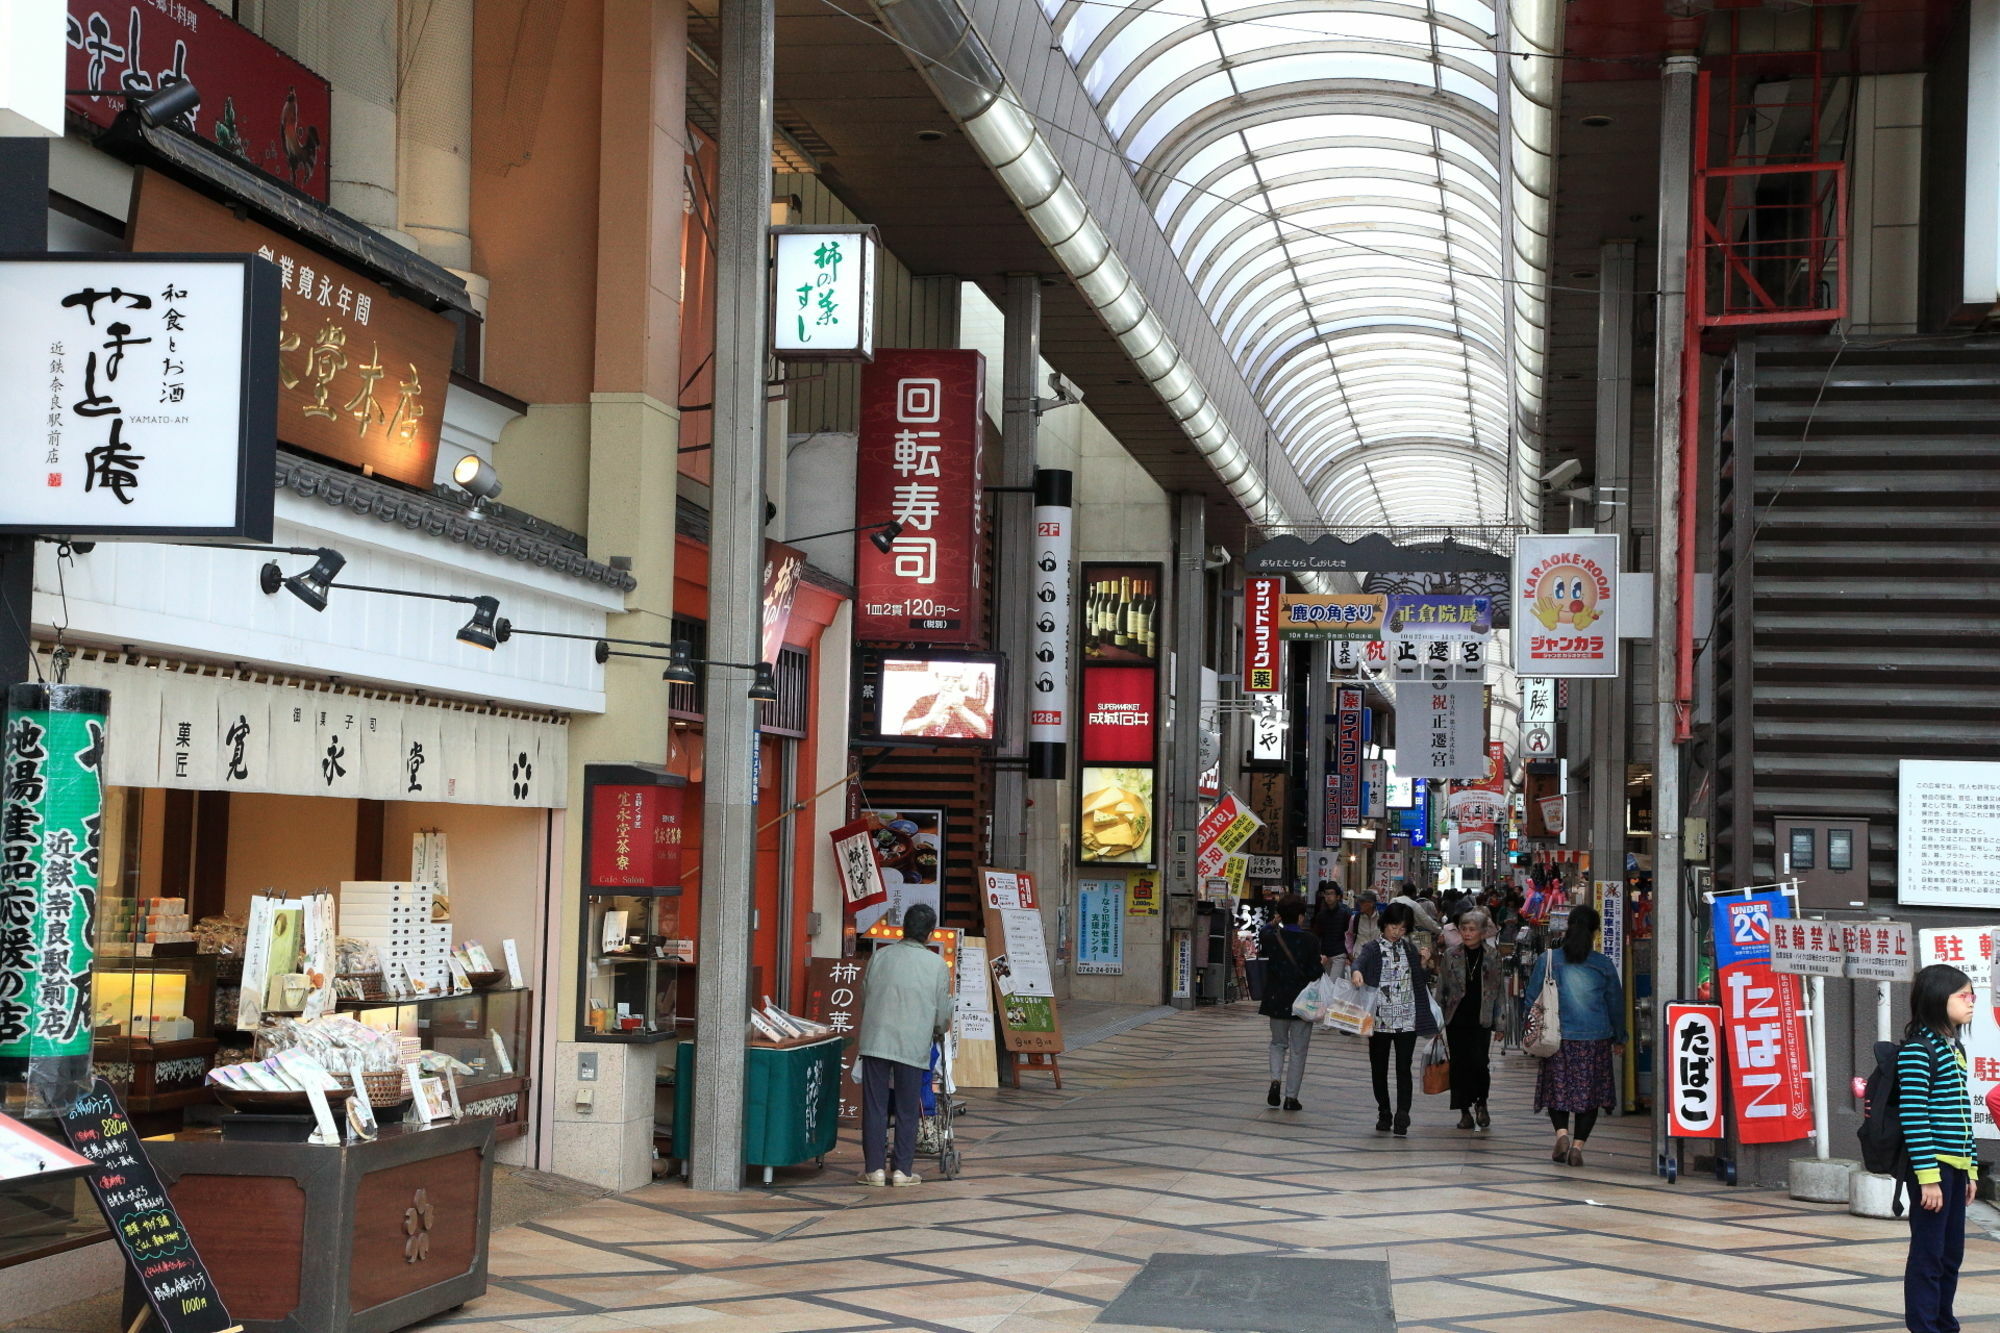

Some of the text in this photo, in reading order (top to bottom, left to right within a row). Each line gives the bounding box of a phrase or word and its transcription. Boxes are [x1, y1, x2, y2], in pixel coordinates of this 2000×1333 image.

[813, 241, 844, 327] 柿の葉
[795, 281, 814, 343] すし
[160, 282, 189, 404] 和食とお酒
[45, 341, 66, 465] 近鉄奈良駅前店
[129, 415, 189, 425] YAMATO-AN
[893, 377, 941, 584] 回転寿司
[1038, 523, 1060, 536] 2F
[1254, 580, 1272, 668] サンドラッグ
[1291, 603, 1374, 622] 鹿の角きり
[1400, 603, 1477, 623] 正倉院展
[1531, 635, 1604, 652] ジャンカラ
[863, 685, 874, 698] 茶
[1253, 671, 1271, 689] 薬
[1088, 711, 1149, 726] 成城石井
[1097, 703, 1141, 711] SUPERMARKET
[175, 722, 192, 777] 菓匠
[1342, 713, 1357, 765] ダイコク
[1213, 807, 1236, 829] Tax
[1134, 879, 1153, 899] 占
[1731, 904, 1768, 915] UNDER
[37, 833, 75, 1041] 近鉄奈良駅前店
[1734, 912, 1769, 943] 20
[1774, 924, 1840, 953] 駐輪禁止
[1842, 927, 1907, 956] 駐輪禁止
[829, 962, 862, 1034] 柿の葉
[1727, 971, 1787, 1119] たばこ
[1680, 1020, 1714, 1123] たばこ
